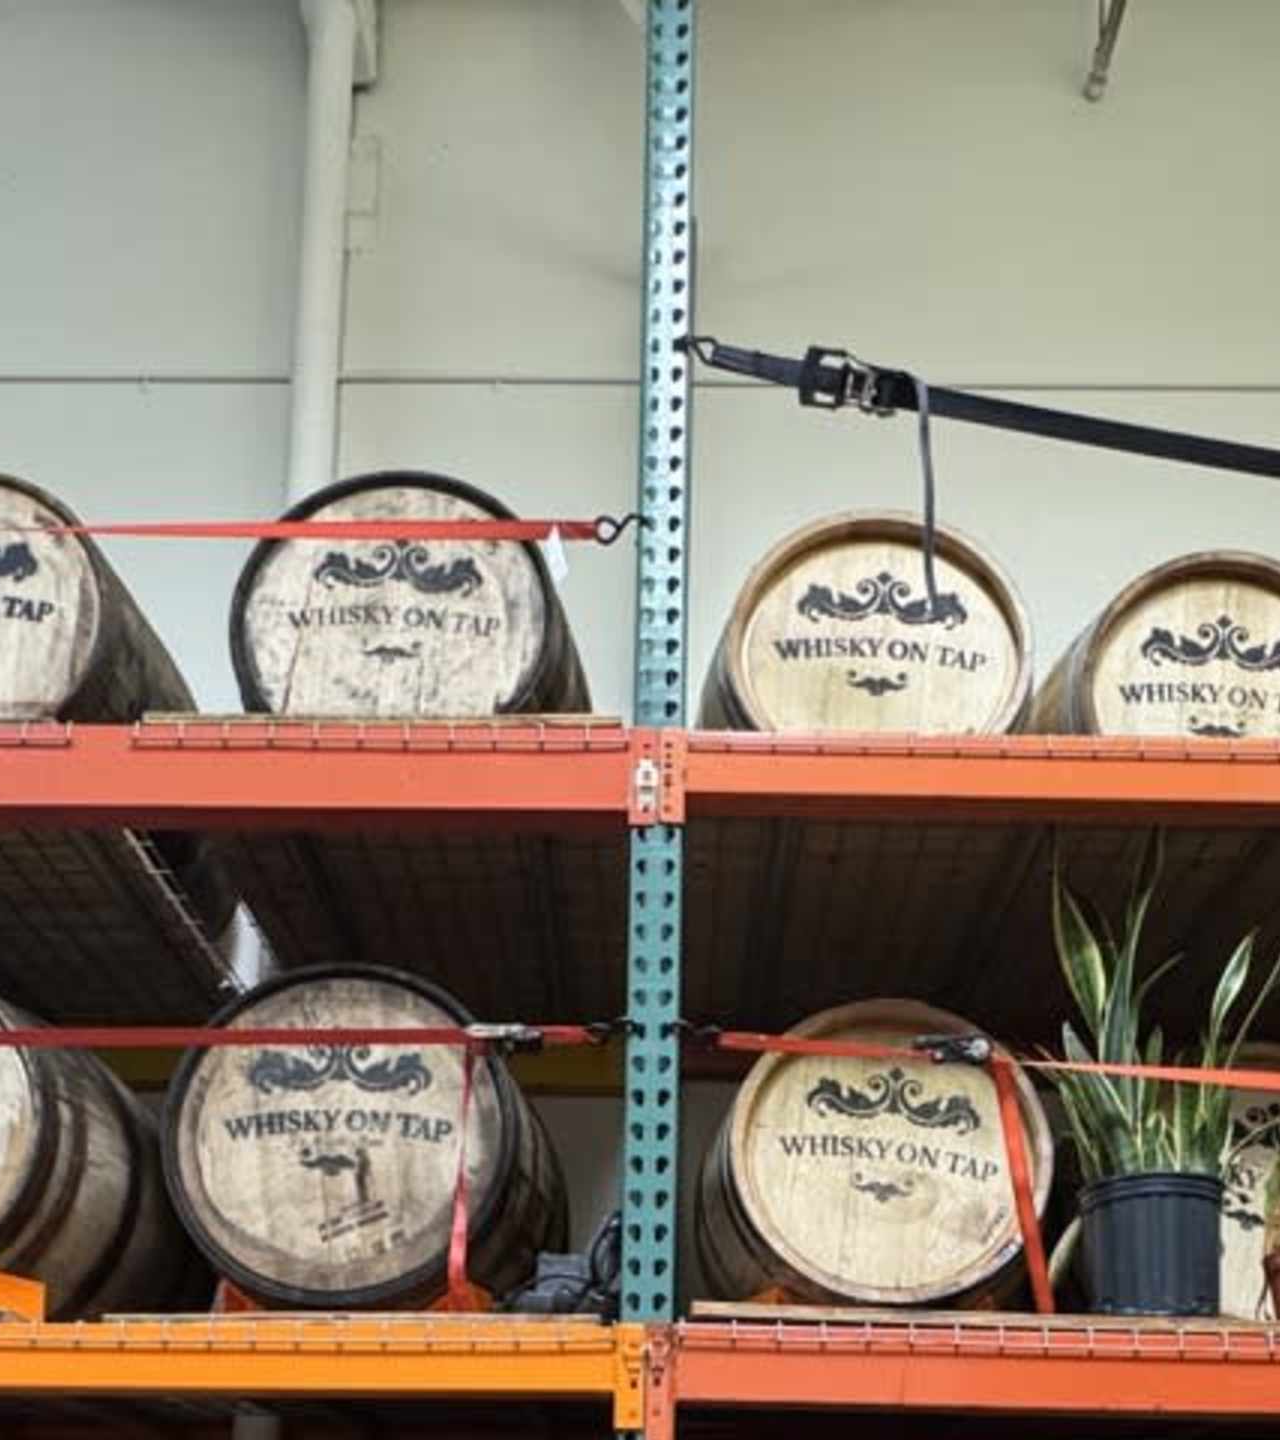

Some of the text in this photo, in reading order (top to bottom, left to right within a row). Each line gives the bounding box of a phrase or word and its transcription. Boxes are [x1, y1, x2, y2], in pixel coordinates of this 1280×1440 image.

[2, 596, 55, 623] TAP
[287, 605, 501, 638] WHISKY ON TAP
[773, 638, 987, 673] WHISKY ON TAP
[1119, 682, 1225, 705] WHISKY
[1228, 686, 1269, 710] ON
[224, 1108, 453, 1143] WHISKY ON TAP
[779, 1135, 999, 1183] WHISKY ON TAP
